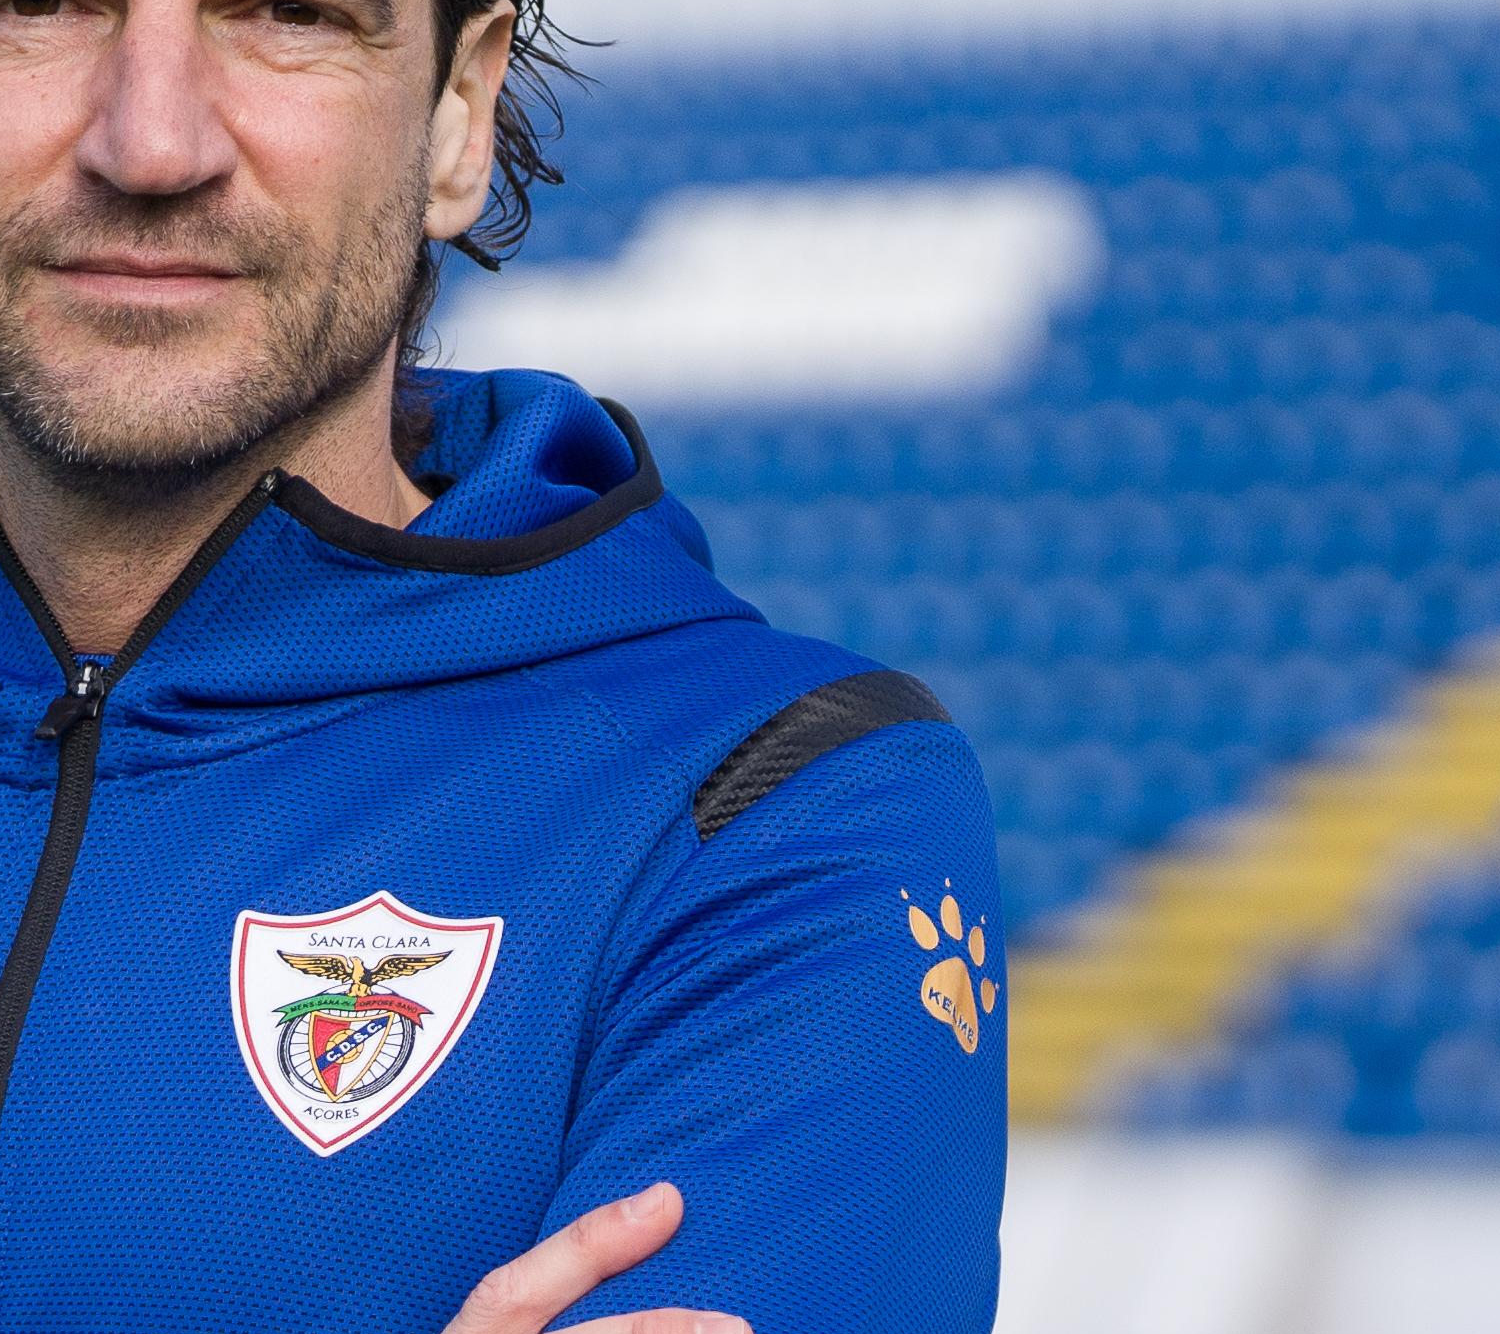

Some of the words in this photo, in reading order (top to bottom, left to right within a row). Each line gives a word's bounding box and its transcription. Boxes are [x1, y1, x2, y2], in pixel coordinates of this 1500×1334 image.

[308, 932, 366, 948] SANTA
[371, 935, 431, 949] CLARA
[303, 1105, 360, 1120] AÇORES
